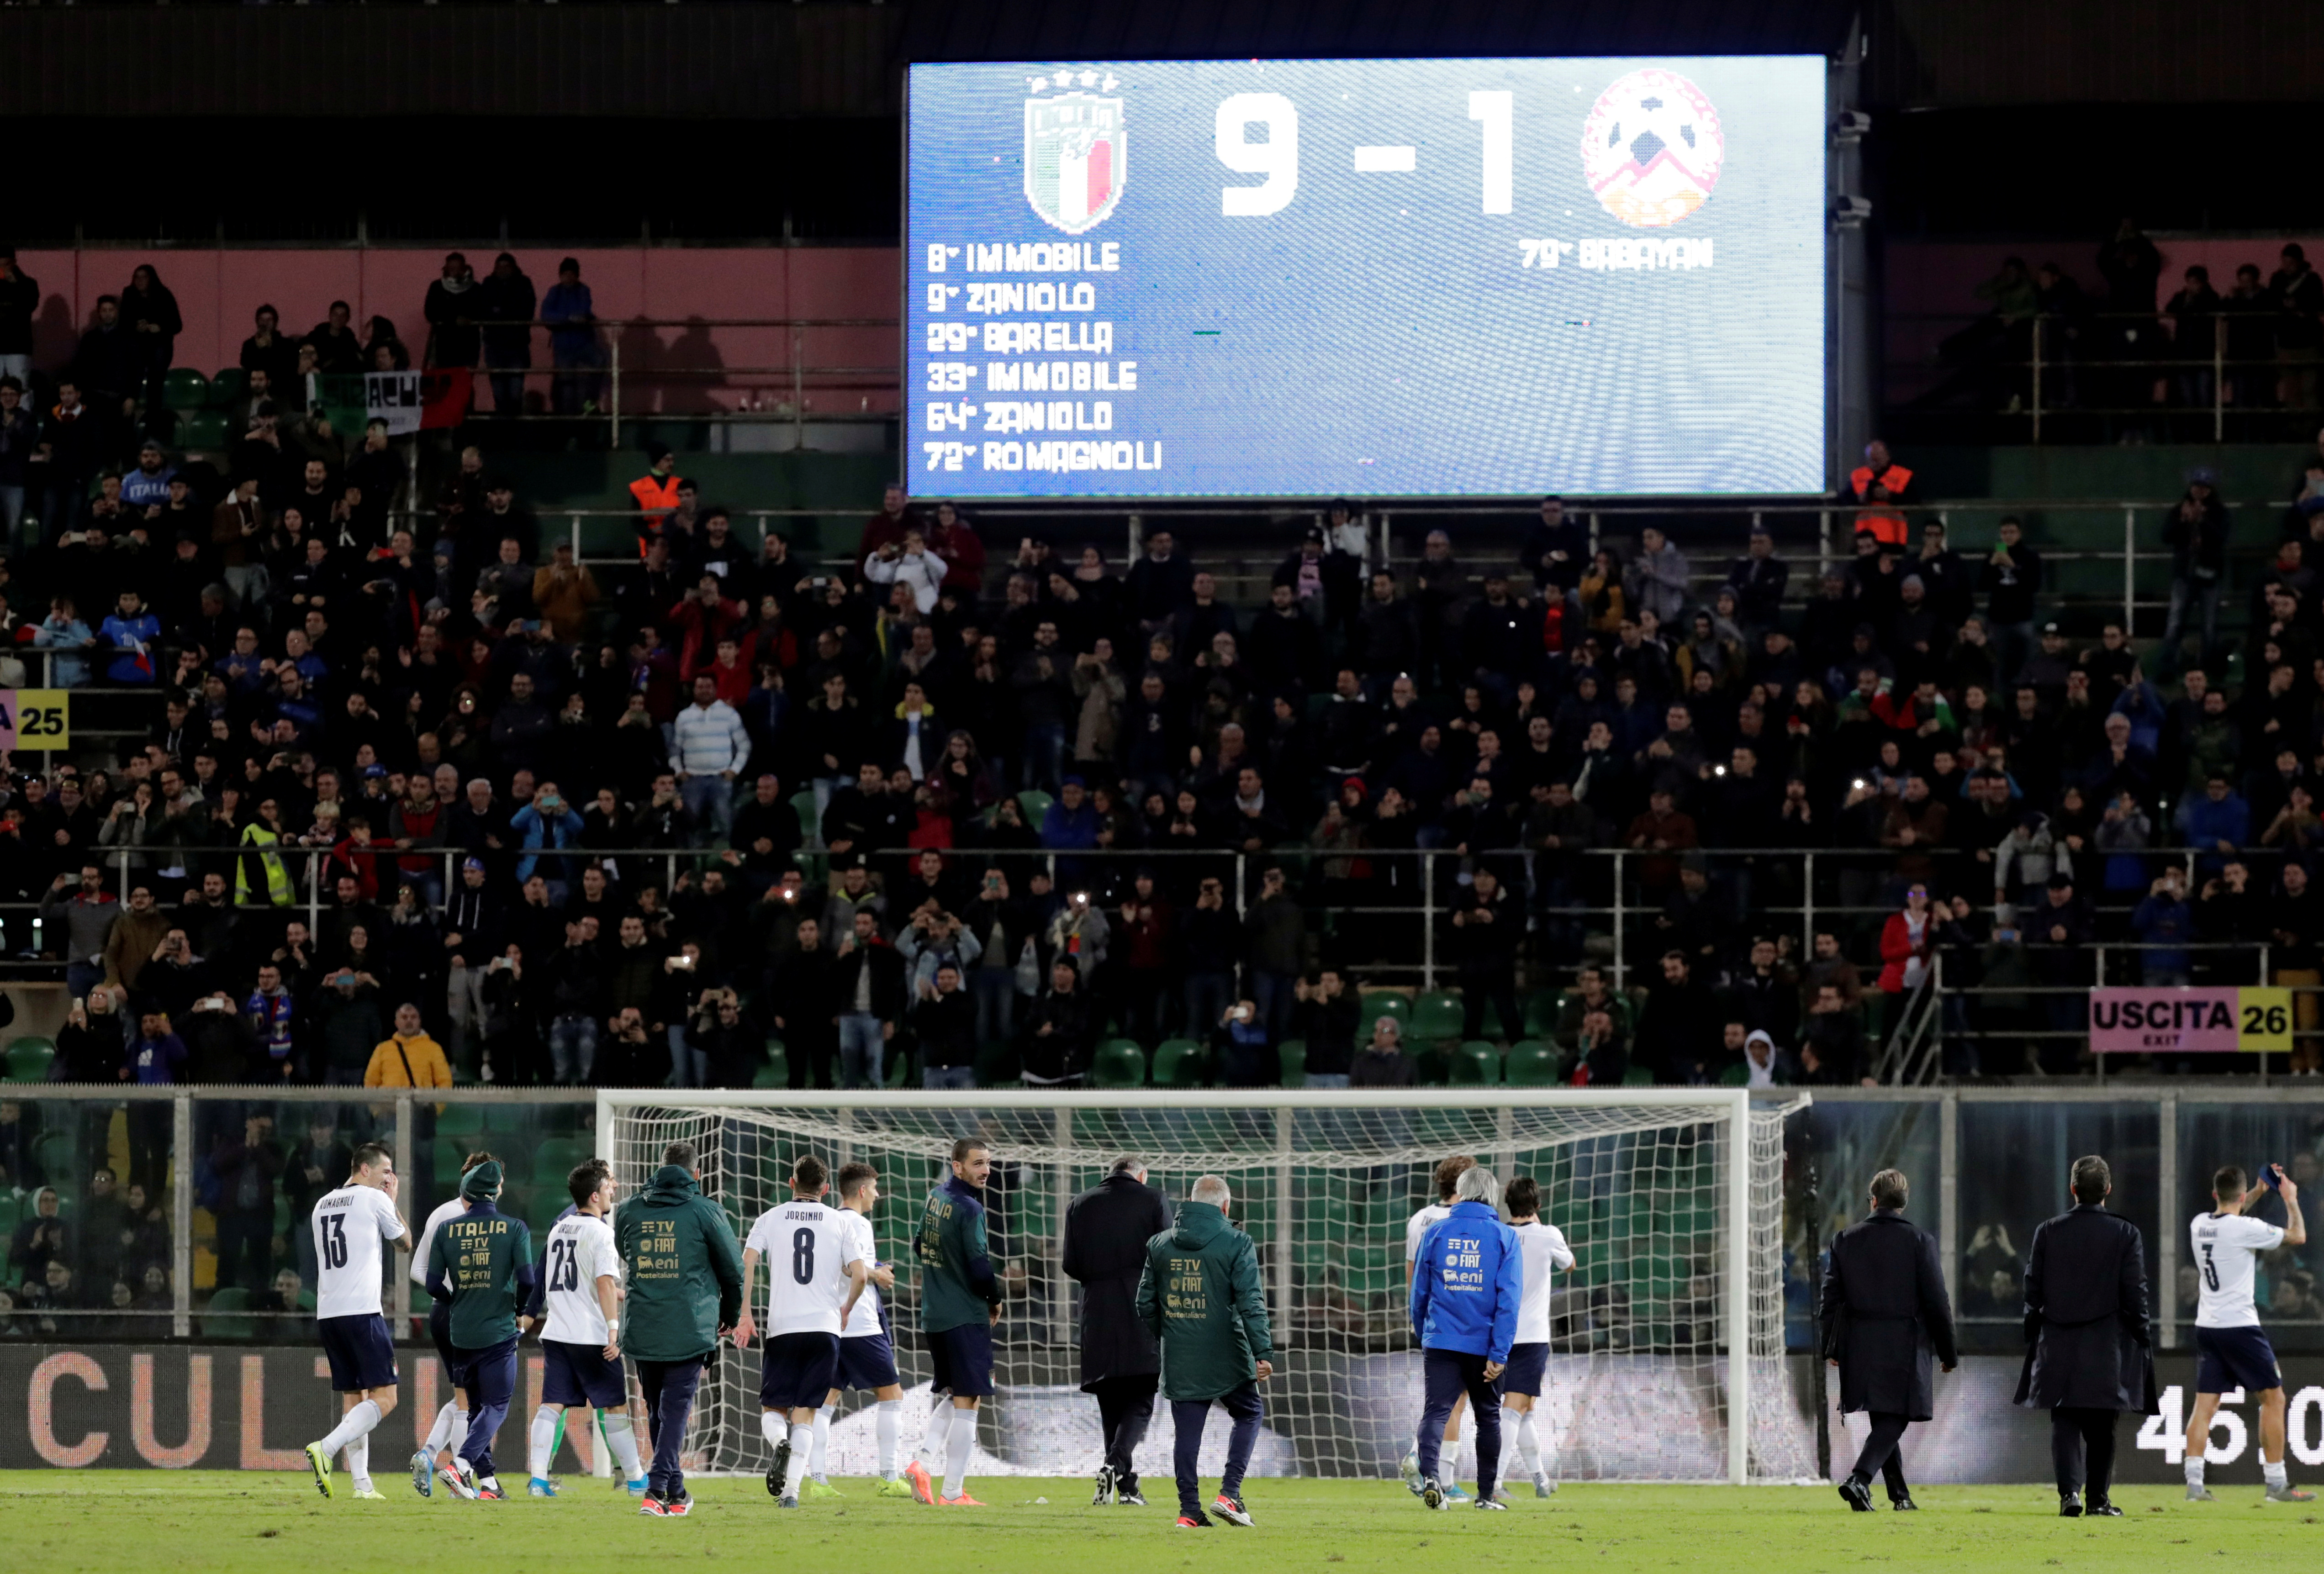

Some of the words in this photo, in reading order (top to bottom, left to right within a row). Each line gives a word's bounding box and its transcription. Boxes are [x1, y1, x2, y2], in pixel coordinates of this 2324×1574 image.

[1215, 93, 1298, 216] 9
[1354, 146, 1416, 171] -
[1469, 91, 1512, 214] 1
[967, 242, 1120, 272] IMMOBILE
[967, 282, 1094, 315] ZANIOLO
[984, 321, 1112, 354] BARELLA
[987, 362, 1137, 391] IMMOBILE
[983, 401, 1112, 434] ZANIOLO
[983, 441, 1162, 473] ROMAGNOLI
[21, 708, 63, 736] 25
[2094, 1001, 2233, 1030] USCITA
[2243, 1006, 2287, 1034] 26
[2143, 1034, 2180, 1046] EXIT
[319, 1195, 354, 1210] ROMAGNOLI
[785, 1210, 824, 1221] JORGINHO
[449, 1220, 507, 1238] ITALIA
[656, 1221, 675, 1232] TV
[320, 1213, 348, 1270] 13
[475, 1237, 489, 1248] TV
[654, 1238, 676, 1253] FIAT
[1463, 1239, 1480, 1250] TV
[472, 1252, 491, 1265] FIAT
[655, 1254, 679, 1269] eni
[793, 1227, 815, 1285] 8
[1459, 1254, 1481, 1269] FIAT
[473, 1266, 491, 1280] eni
[548, 1238, 579, 1293] 23
[1184, 1259, 1201, 1271] TV
[2202, 1244, 2220, 1292] 3
[1182, 1277, 1203, 1292] FIAT
[1459, 1269, 1483, 1284] eni
[1183, 1293, 1206, 1310] eni
